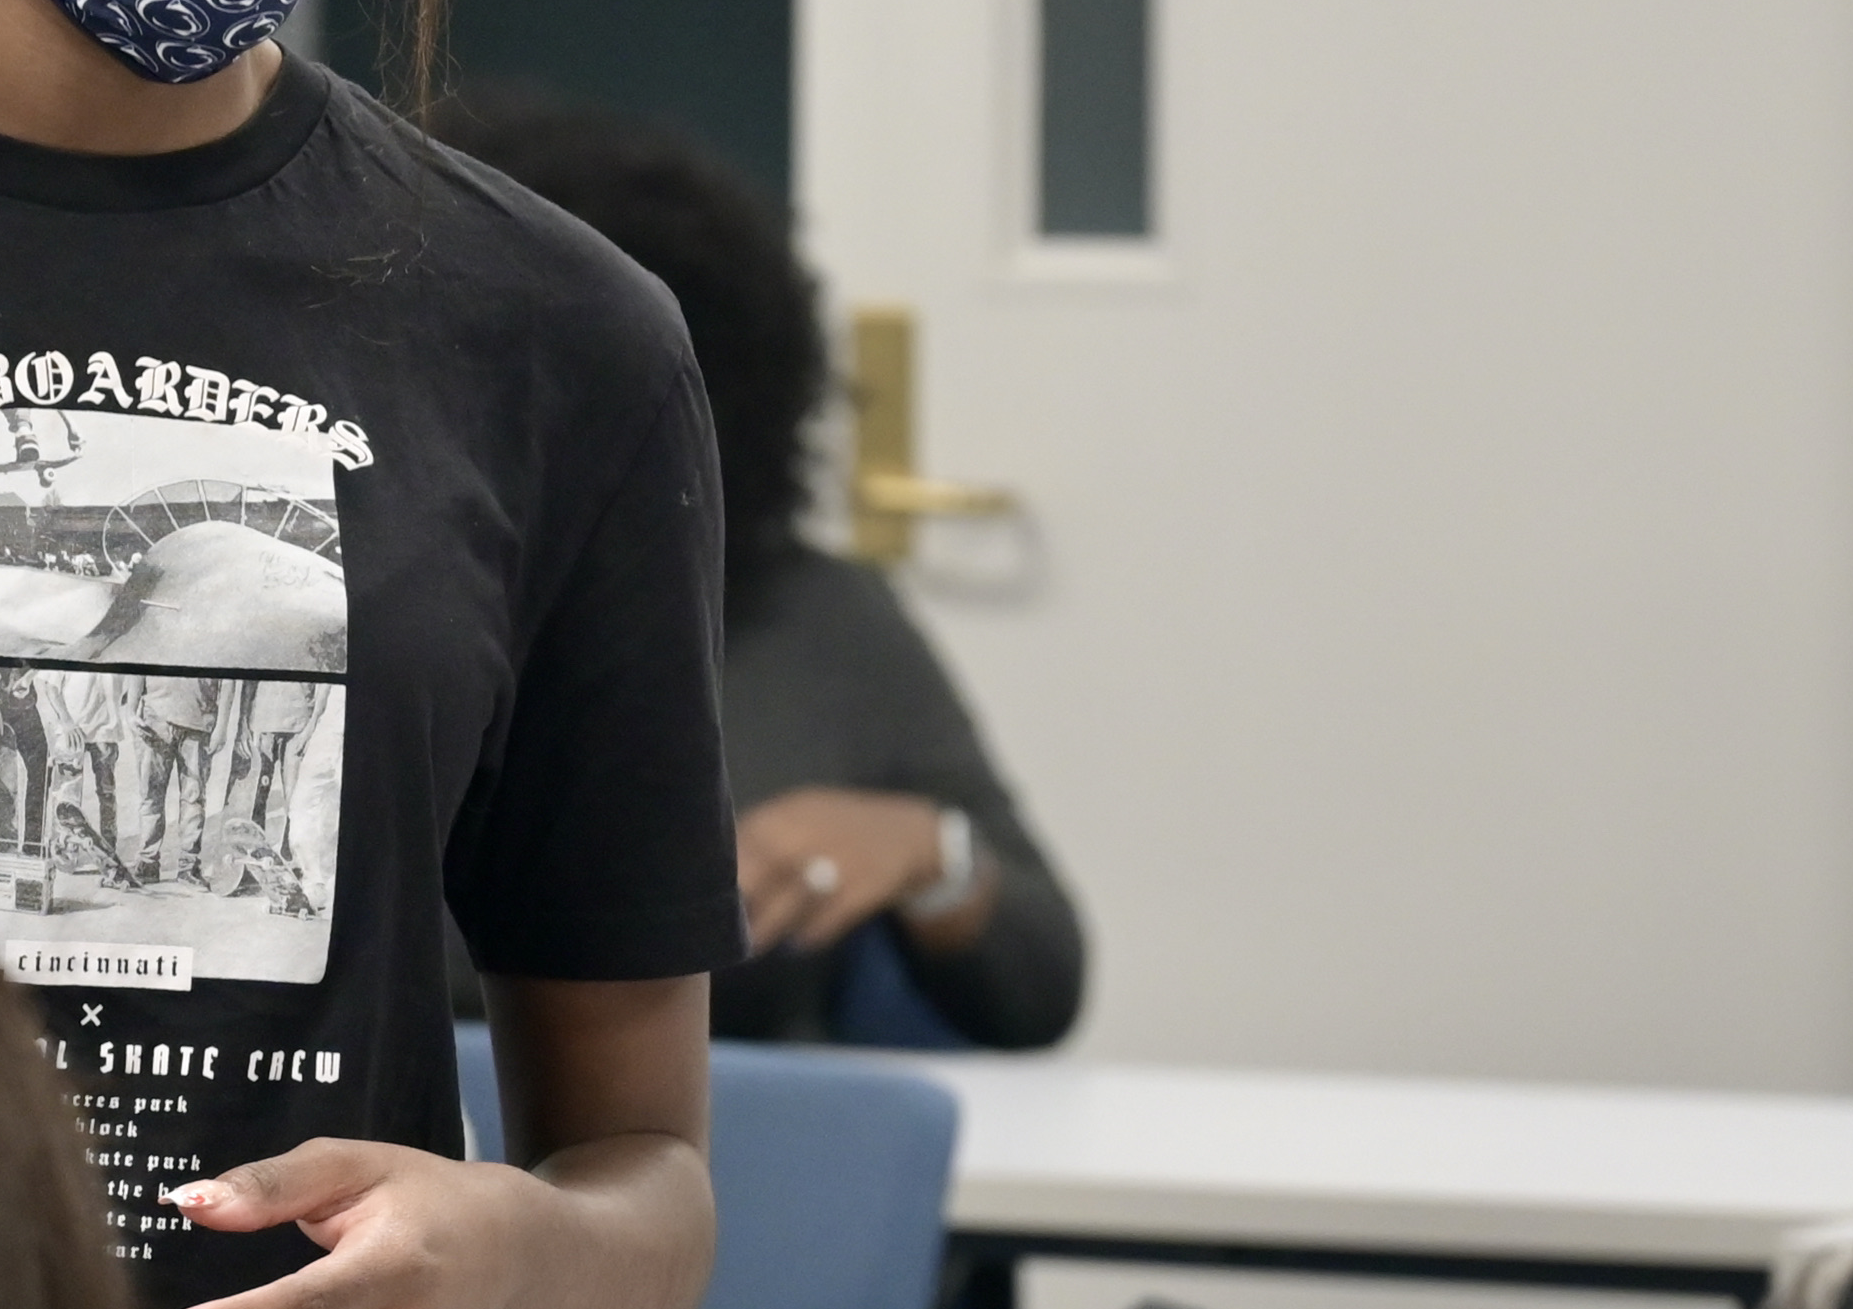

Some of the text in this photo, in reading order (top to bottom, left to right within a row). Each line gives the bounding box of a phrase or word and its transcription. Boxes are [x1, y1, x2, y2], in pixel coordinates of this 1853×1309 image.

[17, 950, 181, 979] cincinnati
[99, 1040, 219, 1080] SKATE
[247, 1048, 341, 1083] CREW
[133, 1094, 188, 1114] park
[146, 1153, 201, 1172] park
[107, 1178, 144, 1201] the
[139, 1214, 193, 1233] park
[107, 1242, 153, 1260] ark
